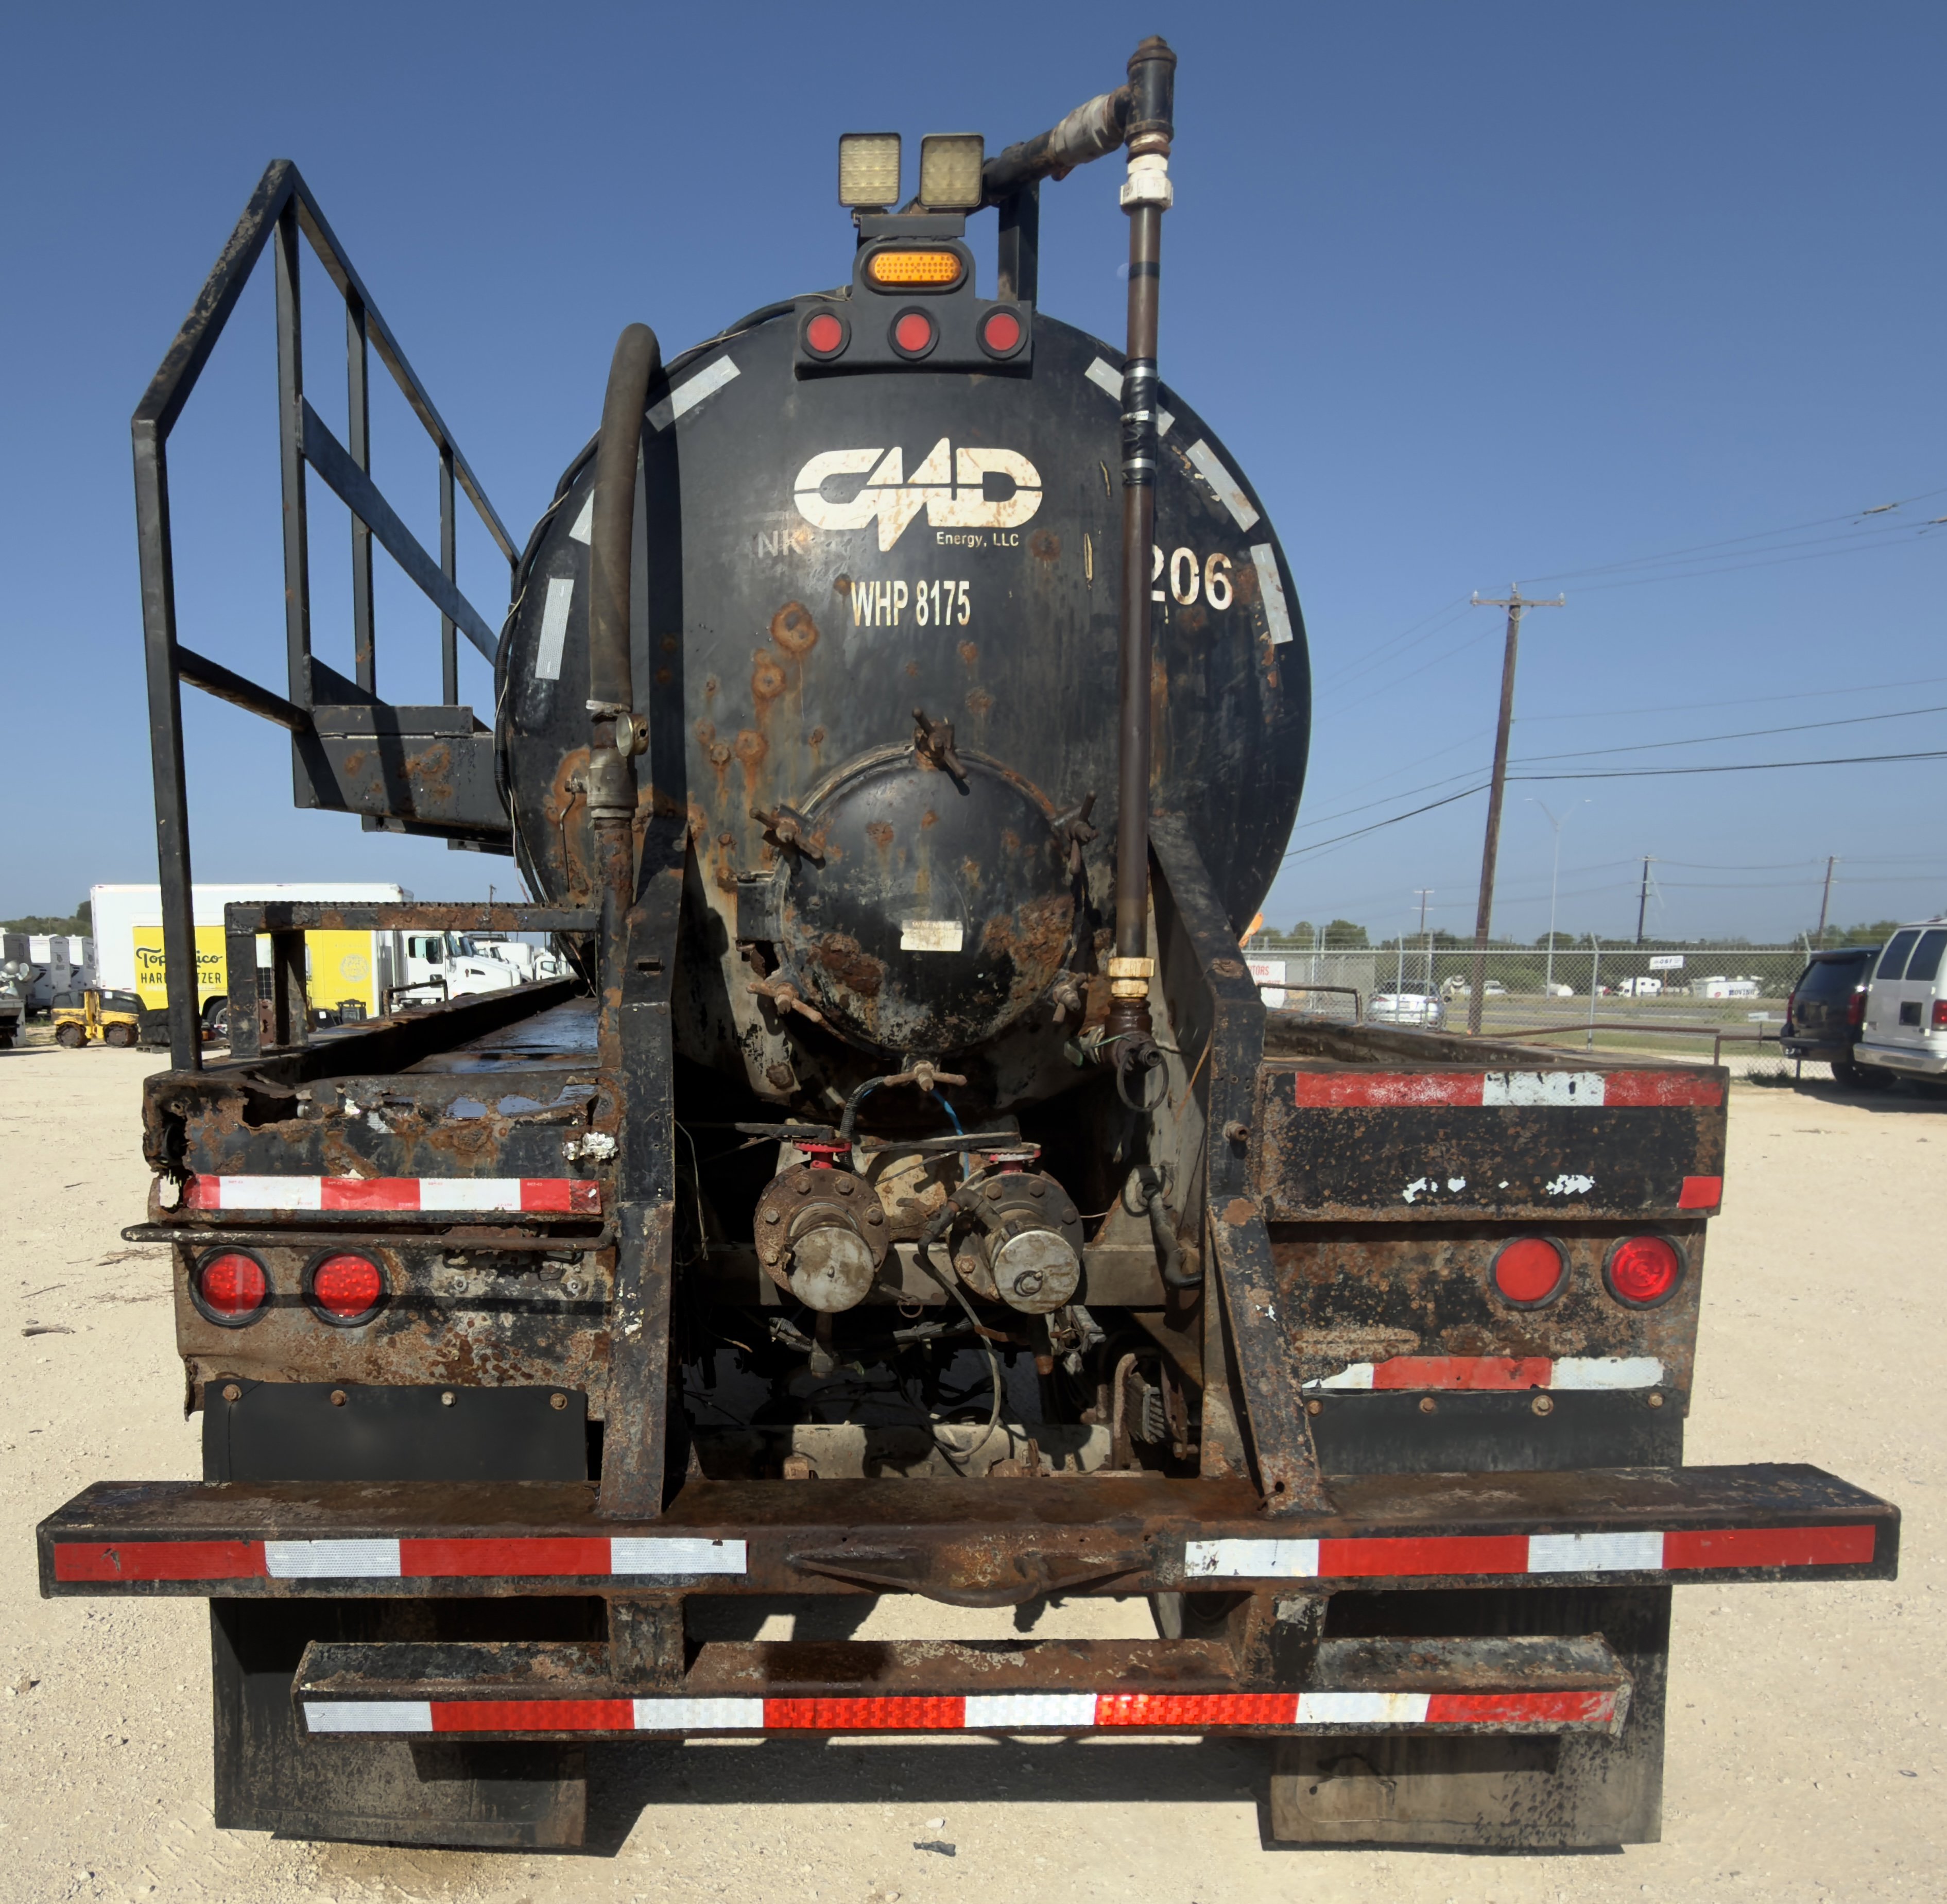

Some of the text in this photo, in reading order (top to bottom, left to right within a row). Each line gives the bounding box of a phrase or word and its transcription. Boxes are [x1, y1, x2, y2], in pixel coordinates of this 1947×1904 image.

[936, 531, 1020, 547] Energy, LLC
[851, 580, 970, 627] WHP 8175
